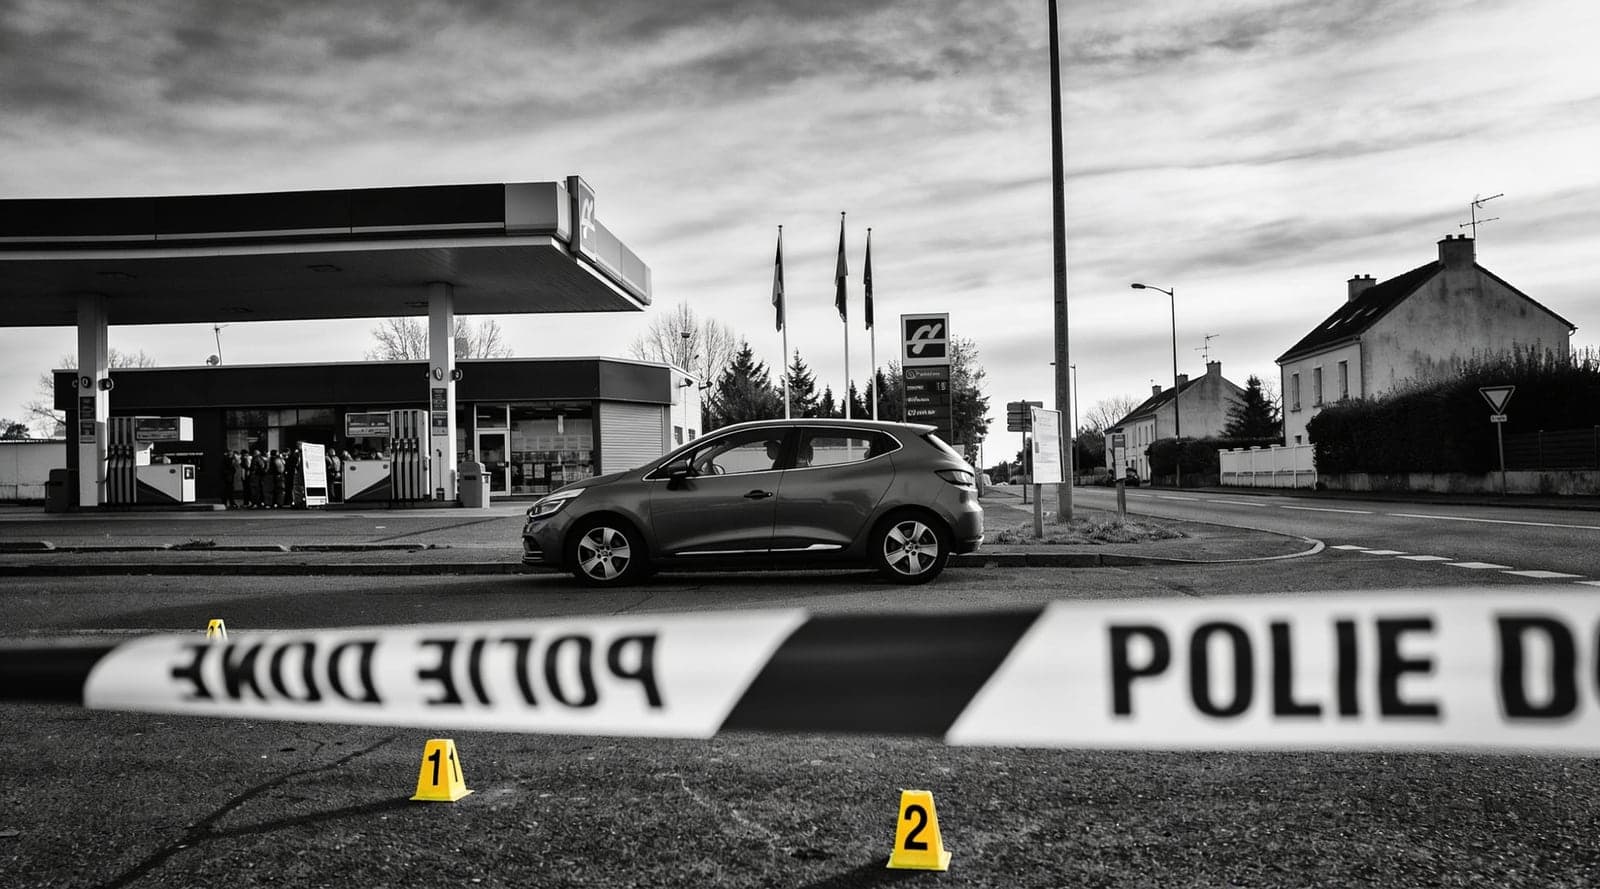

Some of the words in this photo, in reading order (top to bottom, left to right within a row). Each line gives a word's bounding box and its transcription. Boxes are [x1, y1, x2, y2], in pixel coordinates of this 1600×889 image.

[1107, 616, 1442, 720] POLIE
[1495, 614, 1600, 721] D
[428, 749, 441, 786] 1
[904, 804, 928, 850] 2
